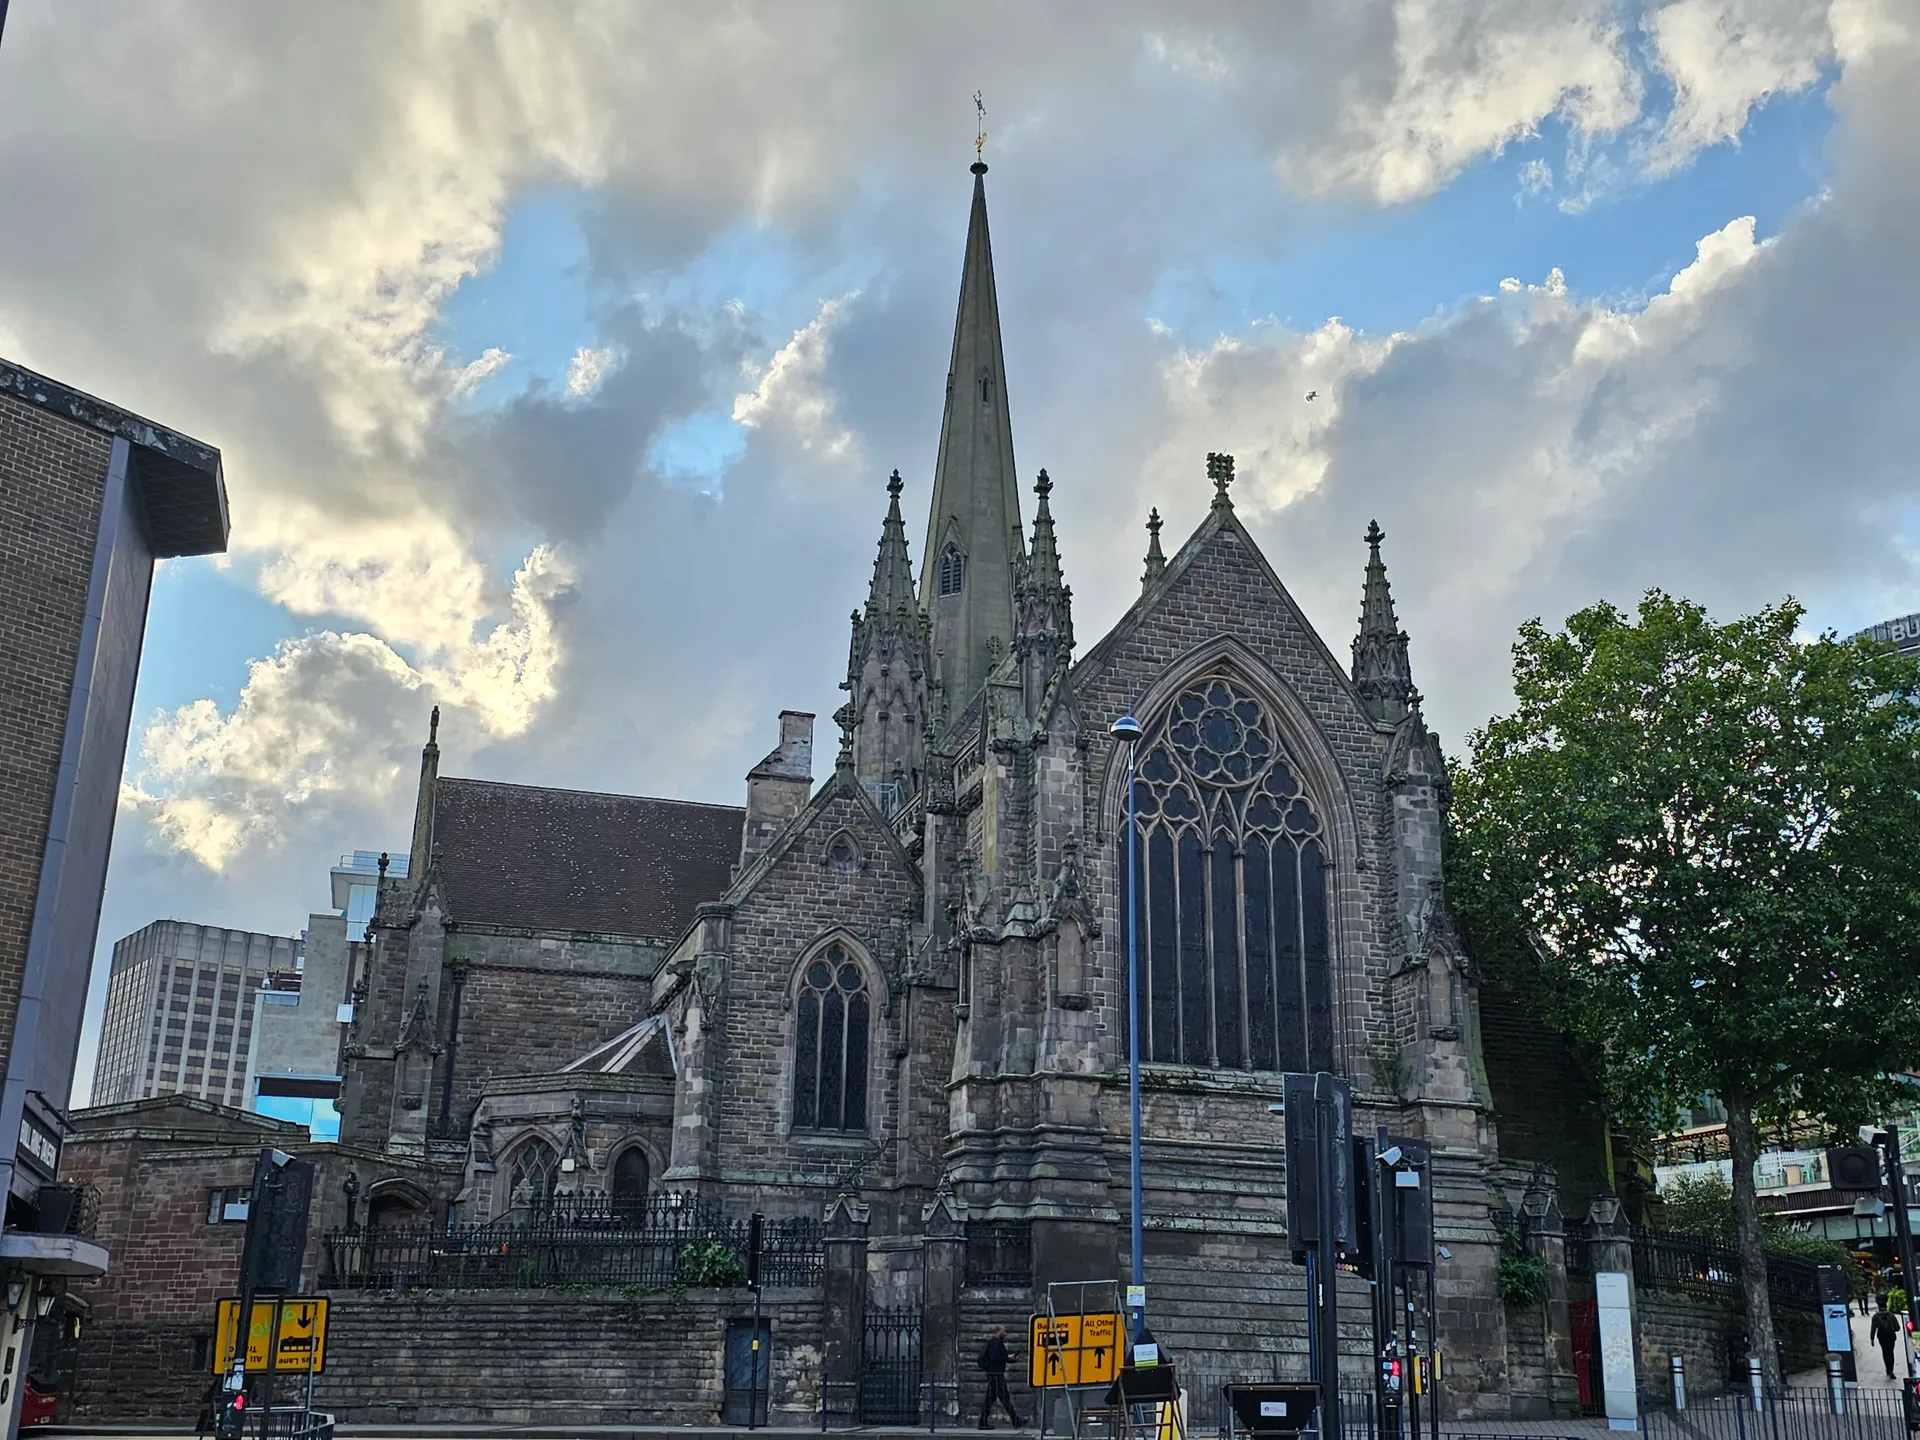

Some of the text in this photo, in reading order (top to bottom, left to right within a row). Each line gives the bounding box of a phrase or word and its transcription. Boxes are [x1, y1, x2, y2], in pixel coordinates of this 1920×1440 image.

[1791, 1220, 1813, 1233] Hut
[1085, 1319, 1114, 1328] All Othe
[1089, 1328, 1111, 1336] Traffic
[250, 1355, 263, 1363] All
[278, 1357, 299, 1365] Lane
